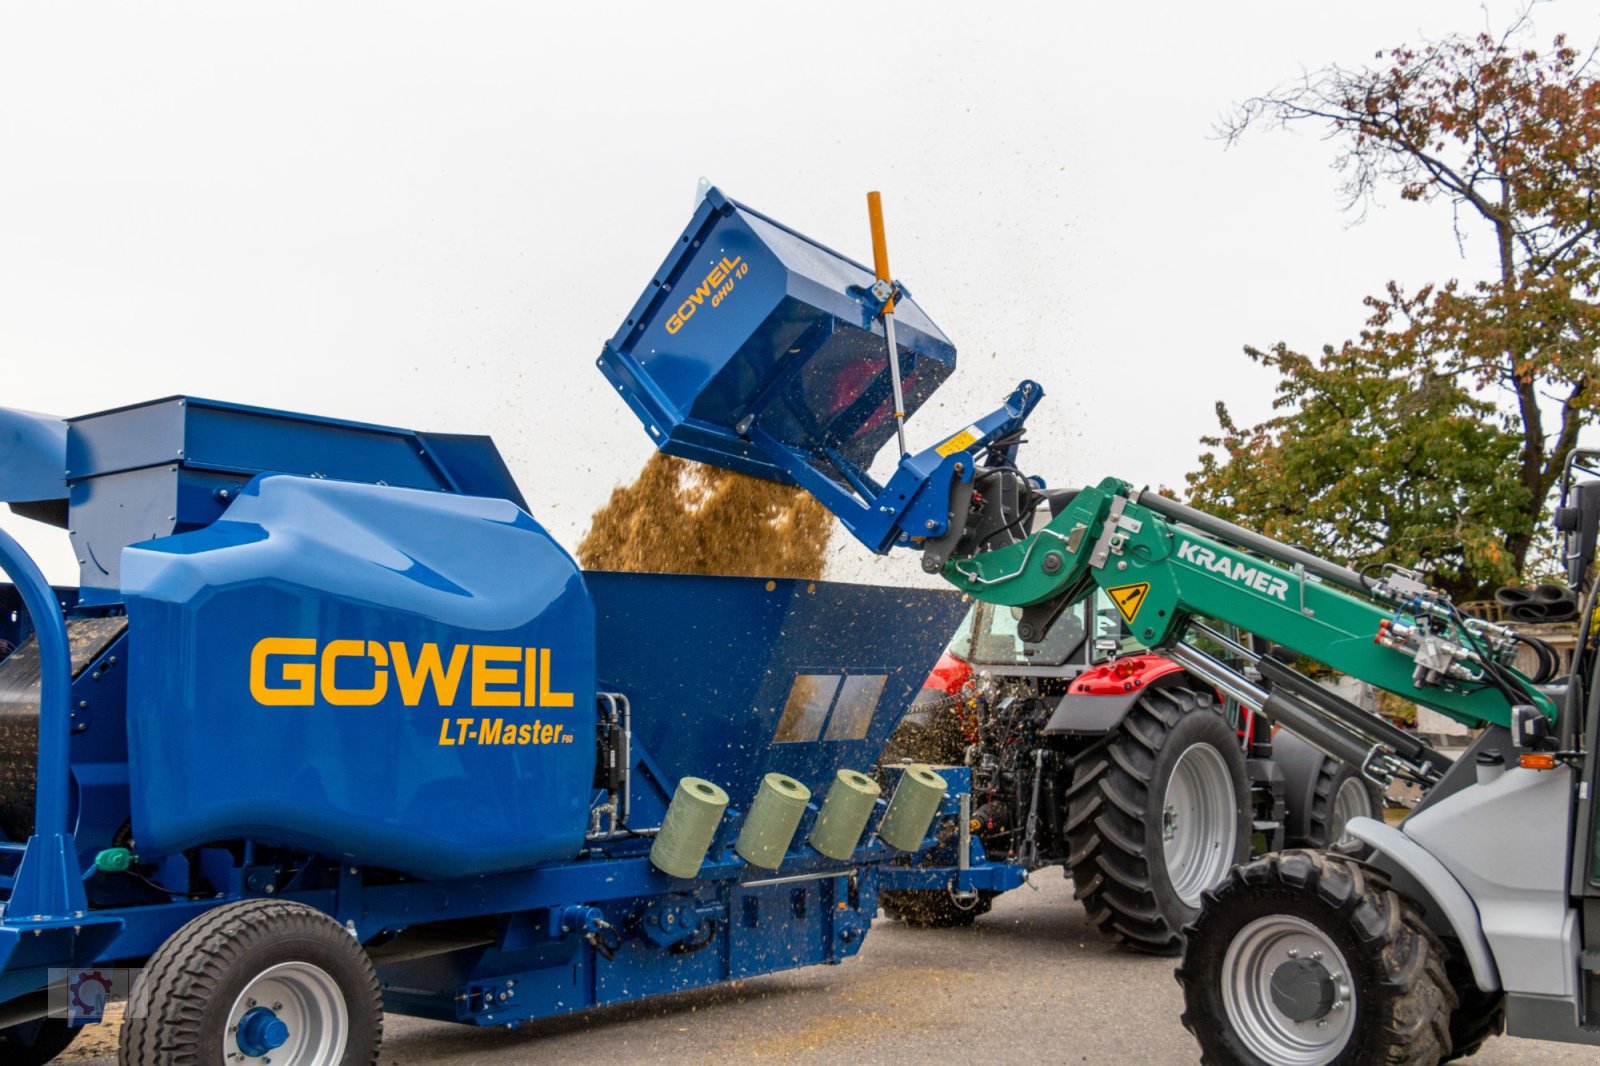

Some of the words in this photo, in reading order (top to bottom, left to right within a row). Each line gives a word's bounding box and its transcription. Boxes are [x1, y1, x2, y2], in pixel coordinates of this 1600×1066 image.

[711, 277, 735, 308] GHU
[735, 262, 749, 280] 10
[1176, 539, 1290, 602] KRAMER
[438, 717, 563, 746] LT-Master
